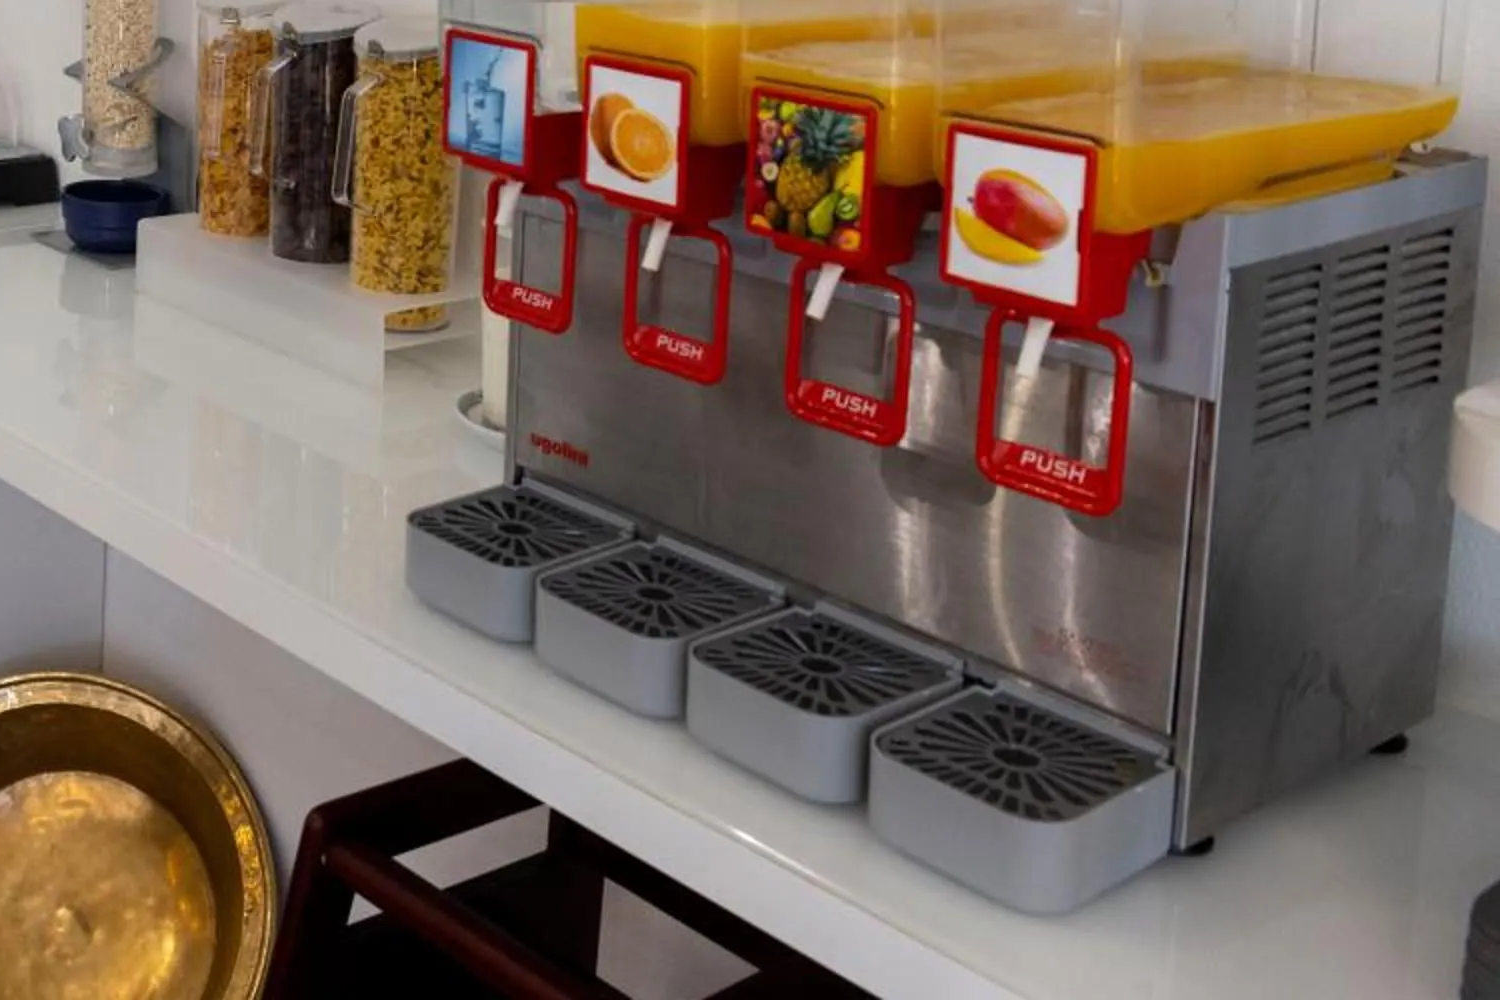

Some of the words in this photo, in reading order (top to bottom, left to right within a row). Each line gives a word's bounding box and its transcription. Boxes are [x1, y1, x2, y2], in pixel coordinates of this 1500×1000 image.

[511, 286, 553, 310] PUSH
[656, 334, 704, 360] PUSH
[821, 388, 877, 418] PUSH
[1020, 449, 1087, 484] PUSH
